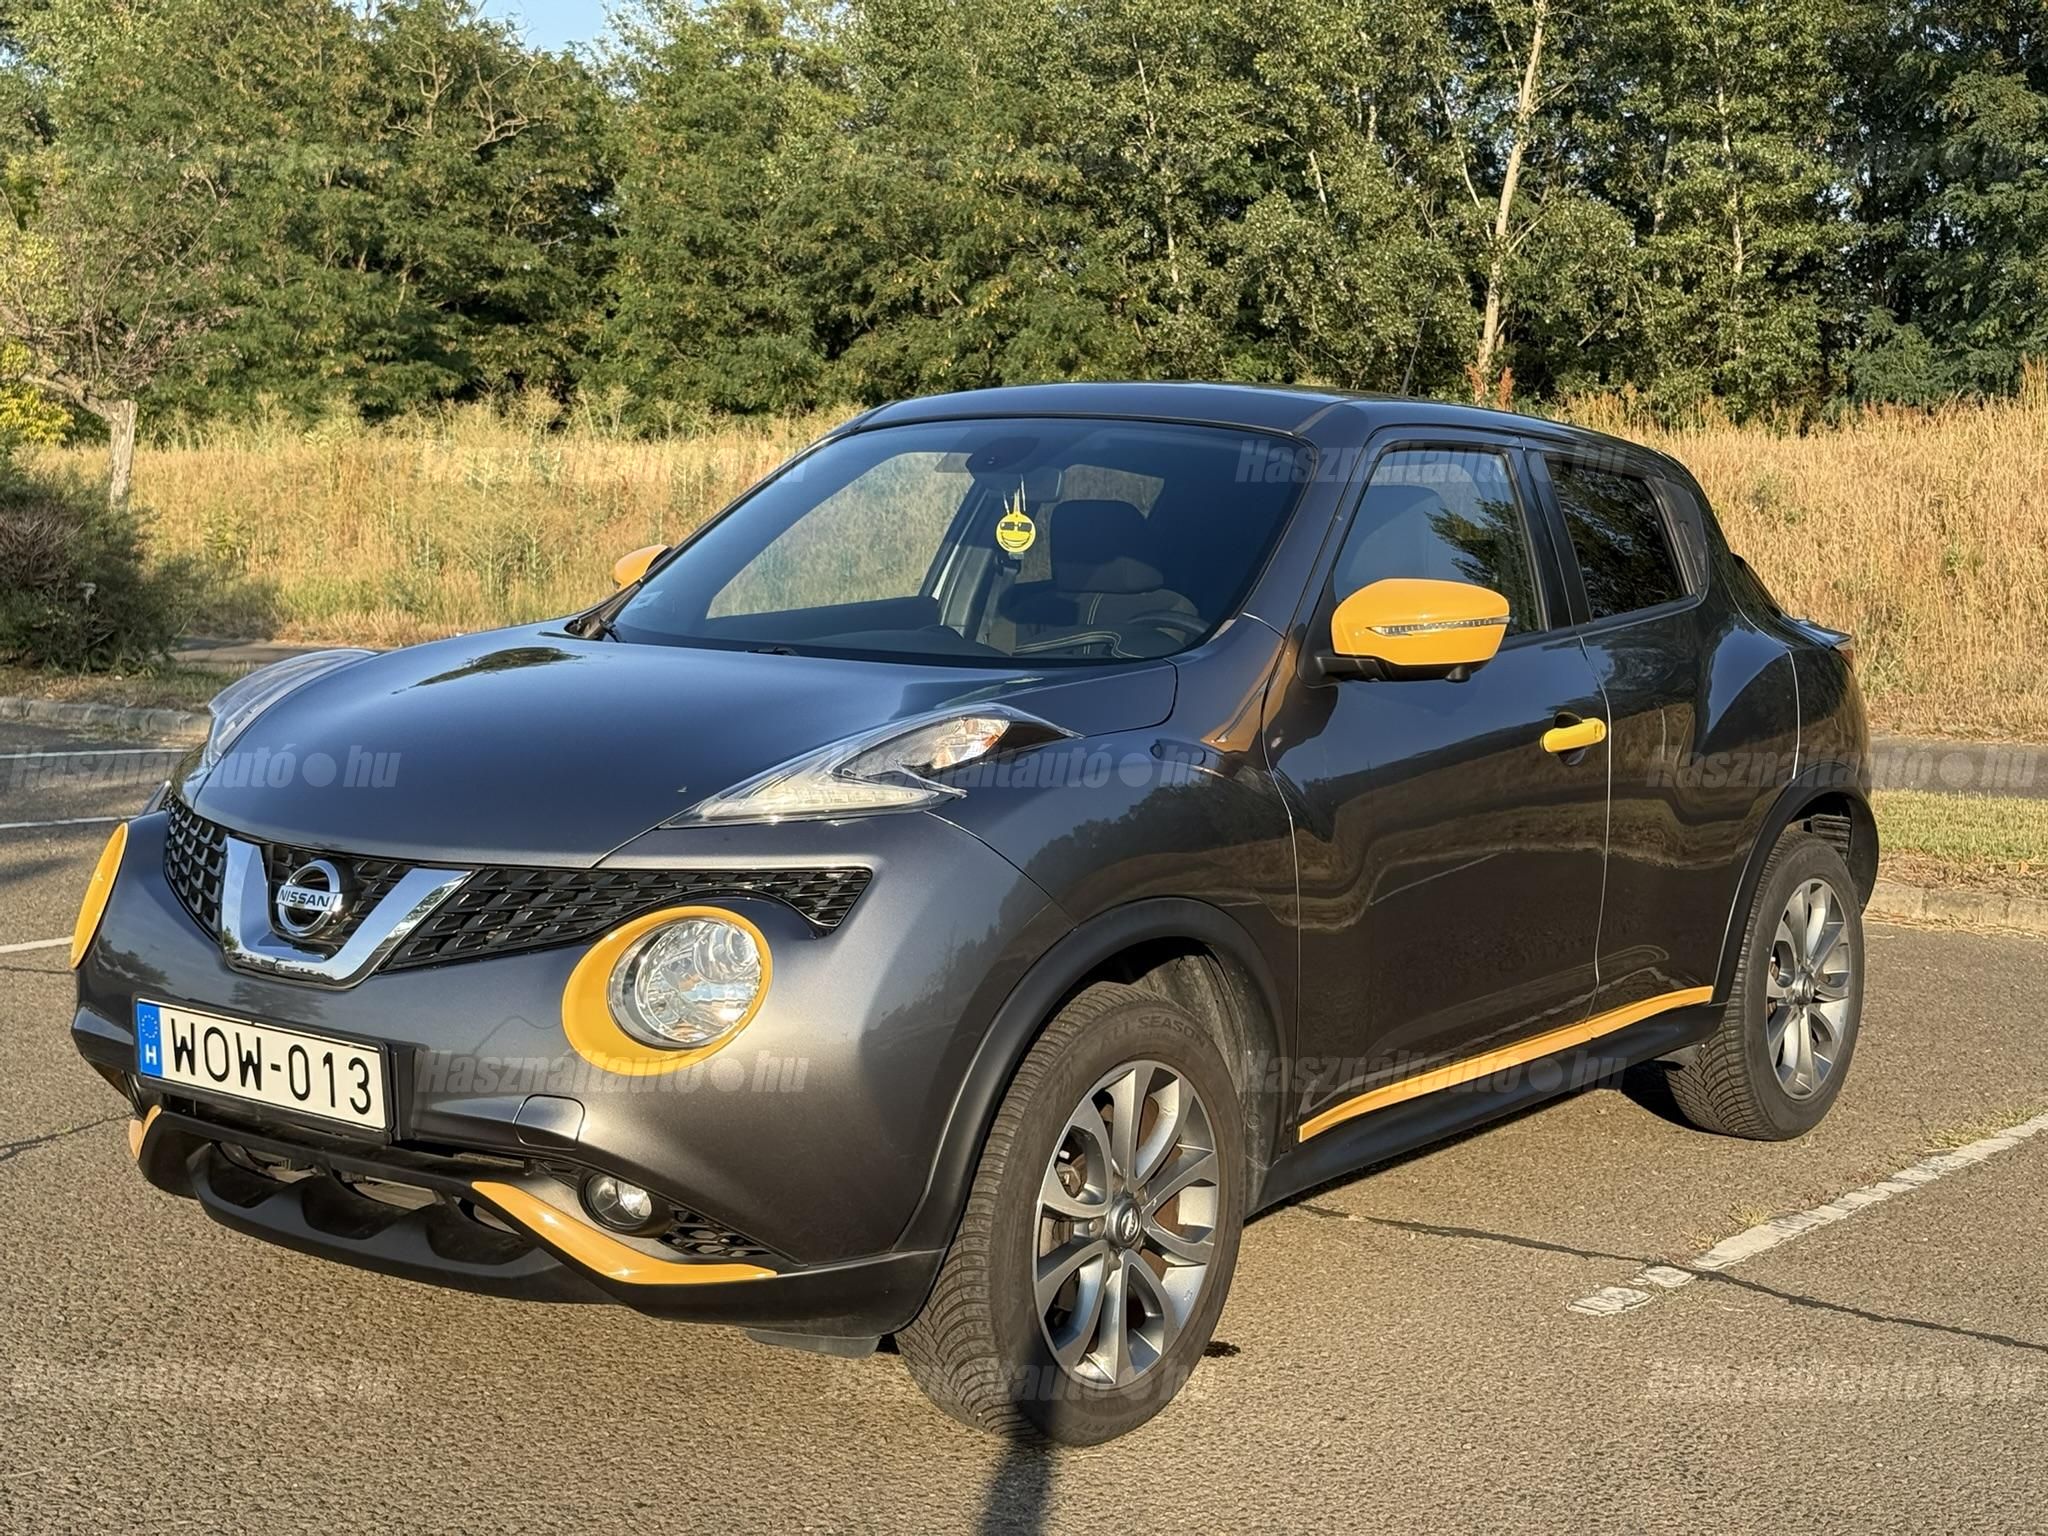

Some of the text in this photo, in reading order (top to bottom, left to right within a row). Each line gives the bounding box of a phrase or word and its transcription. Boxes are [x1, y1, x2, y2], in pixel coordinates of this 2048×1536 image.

[279, 889, 330, 907] NISSAN
[1138, 1015, 1206, 1048] SEASON
[145, 1018, 372, 1115] H WOW-013
